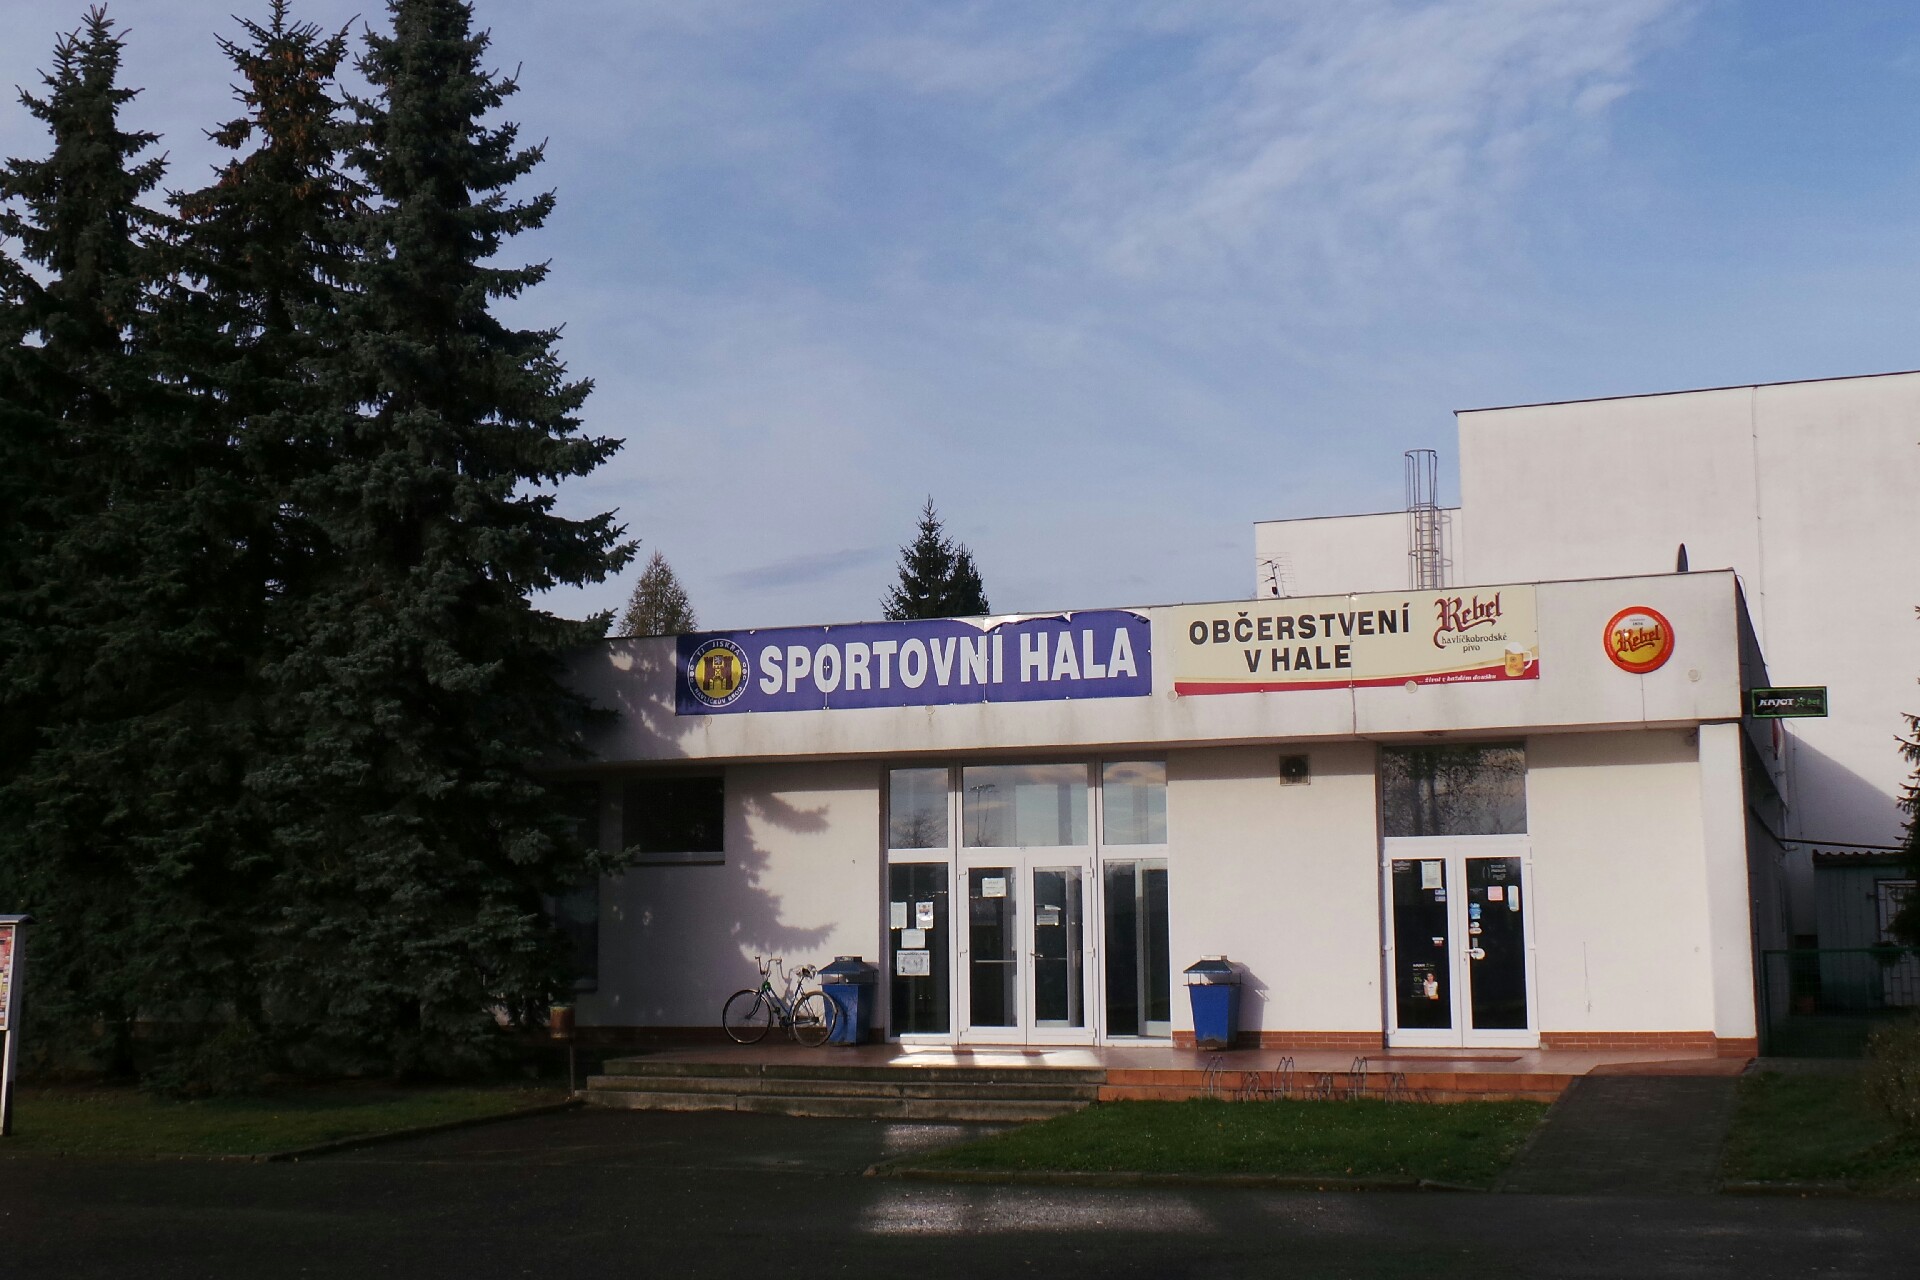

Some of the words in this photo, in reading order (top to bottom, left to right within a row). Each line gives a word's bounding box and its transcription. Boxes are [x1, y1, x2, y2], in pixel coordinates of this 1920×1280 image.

[1189, 602, 1410, 645] OBČERSTVENÍ
[1433, 591, 1504, 649] Rebel
[712, 641, 741, 656] JISKRA
[1441, 632, 1508, 645] havlíčkobrodské
[1462, 644, 1481, 653] pivo
[1615, 624, 1661, 662] Rebel
[759, 627, 1003, 695] SPORTOVNÍ
[1020, 627, 1138, 683] HALA
[1244, 650, 1262, 673] V
[1271, 644, 1352, 672] HALE
[1758, 698, 1794, 707] KAJOT
